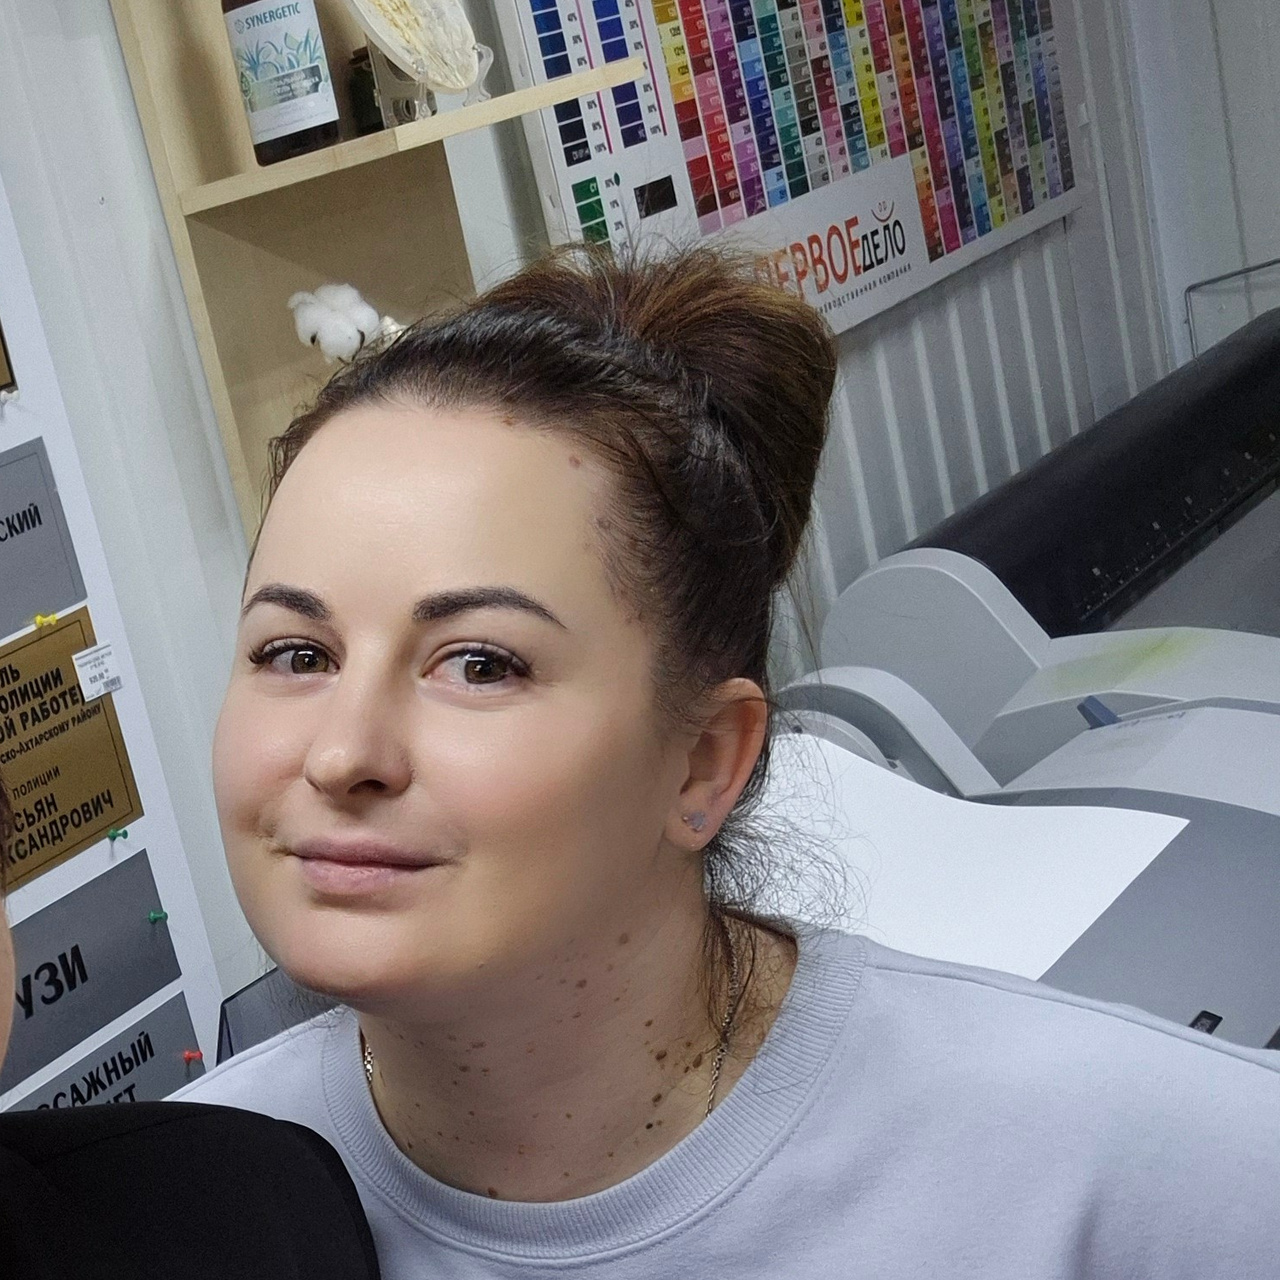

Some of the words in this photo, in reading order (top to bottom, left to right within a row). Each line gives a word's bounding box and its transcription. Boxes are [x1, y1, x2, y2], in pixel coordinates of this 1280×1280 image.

[245, 2, 300, 30] SYNERGETIC
[12, 765, 61, 801] ПОЛИЦИИ
[15, 943, 89, 1020] УЗИ
[36, 1031, 156, 1111] САЖНЫЙ
